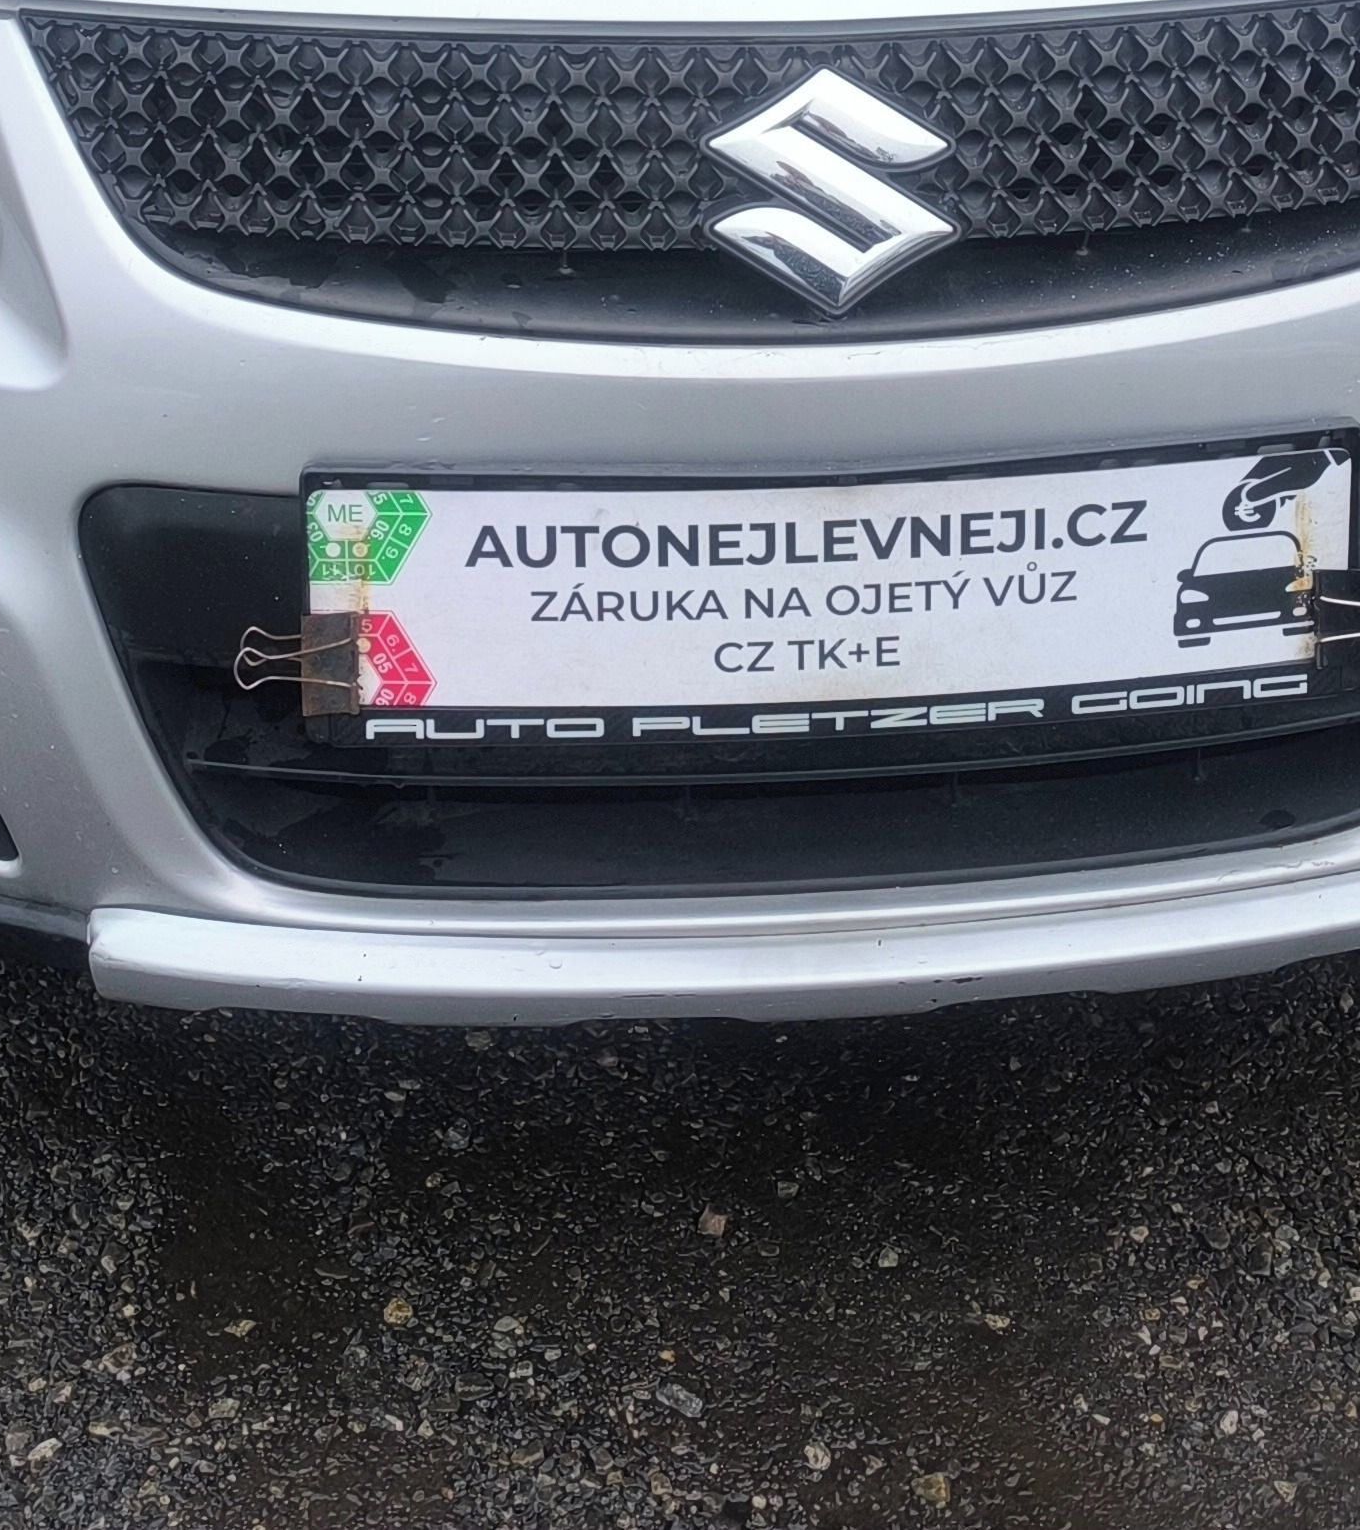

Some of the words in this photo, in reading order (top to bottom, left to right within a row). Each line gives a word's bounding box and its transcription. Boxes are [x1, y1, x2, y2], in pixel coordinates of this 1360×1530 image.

[327, 504, 363, 523] ME
[465, 500, 1148, 569] AUTONEJLEVNEJI.CZ
[530, 583, 729, 622] ZÁRUKA
[744, 587, 812, 619] NA
[826, 571, 971, 616] OJETÝ
[983, 561, 1078, 607] VŮZ
[714, 642, 775, 673] CZ
[787, 636, 901, 671] TK+E
[365, 717, 605, 740] AUTO
[632, 698, 1045, 738] PLETZER
[1071, 673, 1308, 715] GOING
